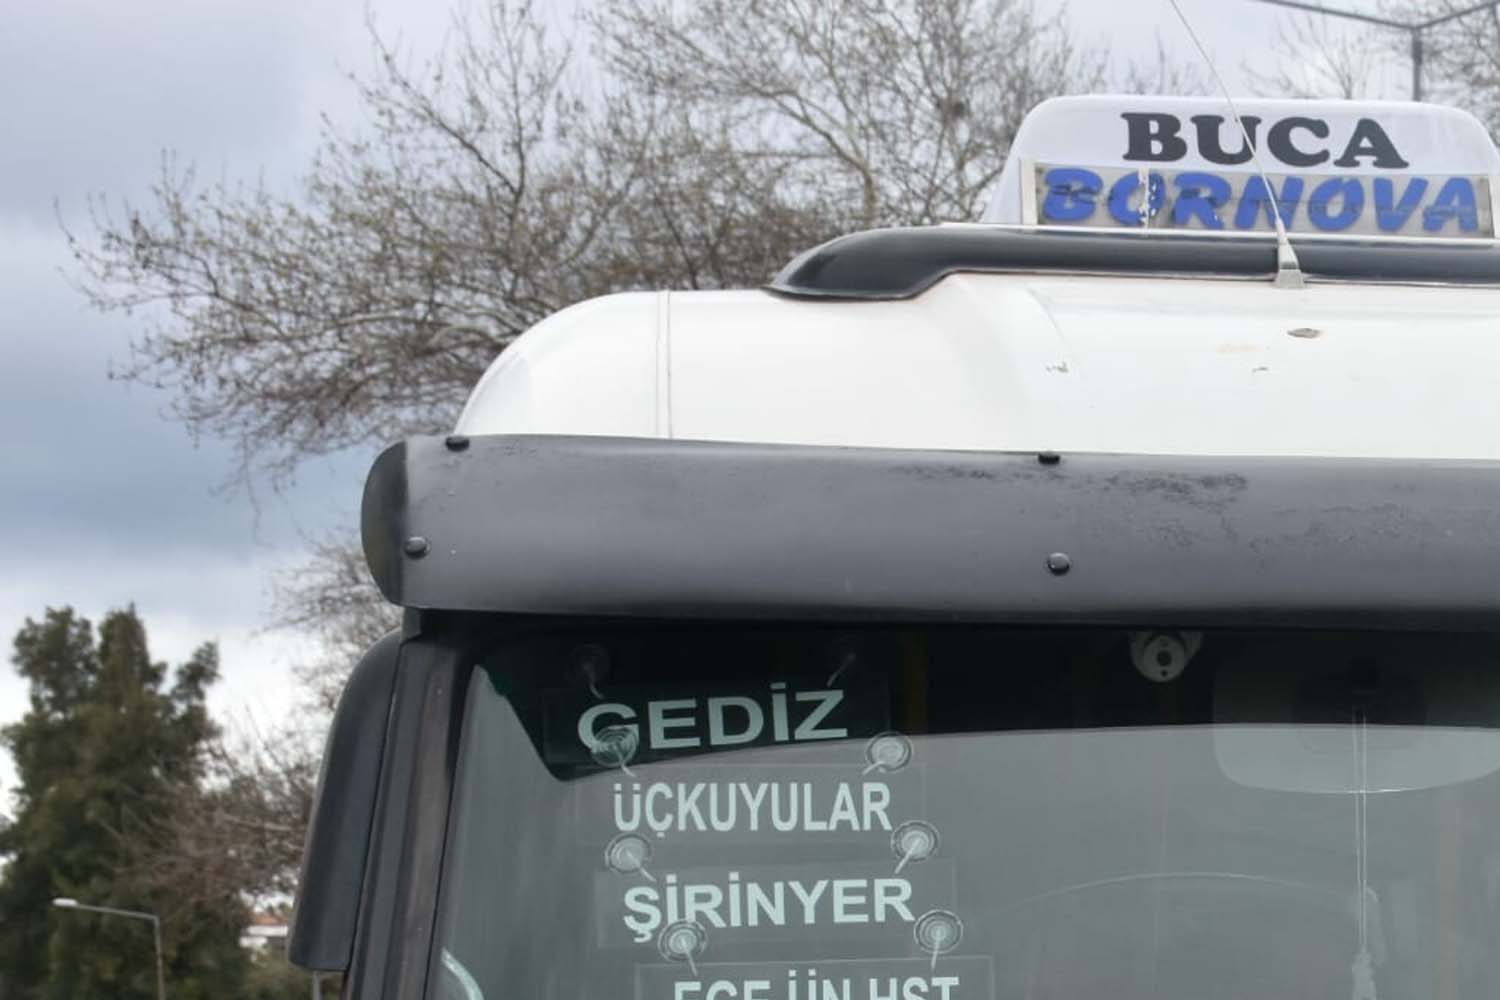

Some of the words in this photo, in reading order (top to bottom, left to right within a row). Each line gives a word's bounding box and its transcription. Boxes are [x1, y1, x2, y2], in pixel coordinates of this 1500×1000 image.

[1120, 112, 1409, 169] BUCA
[1041, 167, 1479, 232] BORNOVA
[577, 682, 849, 753] GEDİZ
[623, 871, 916, 943] ŞİRİNYER
